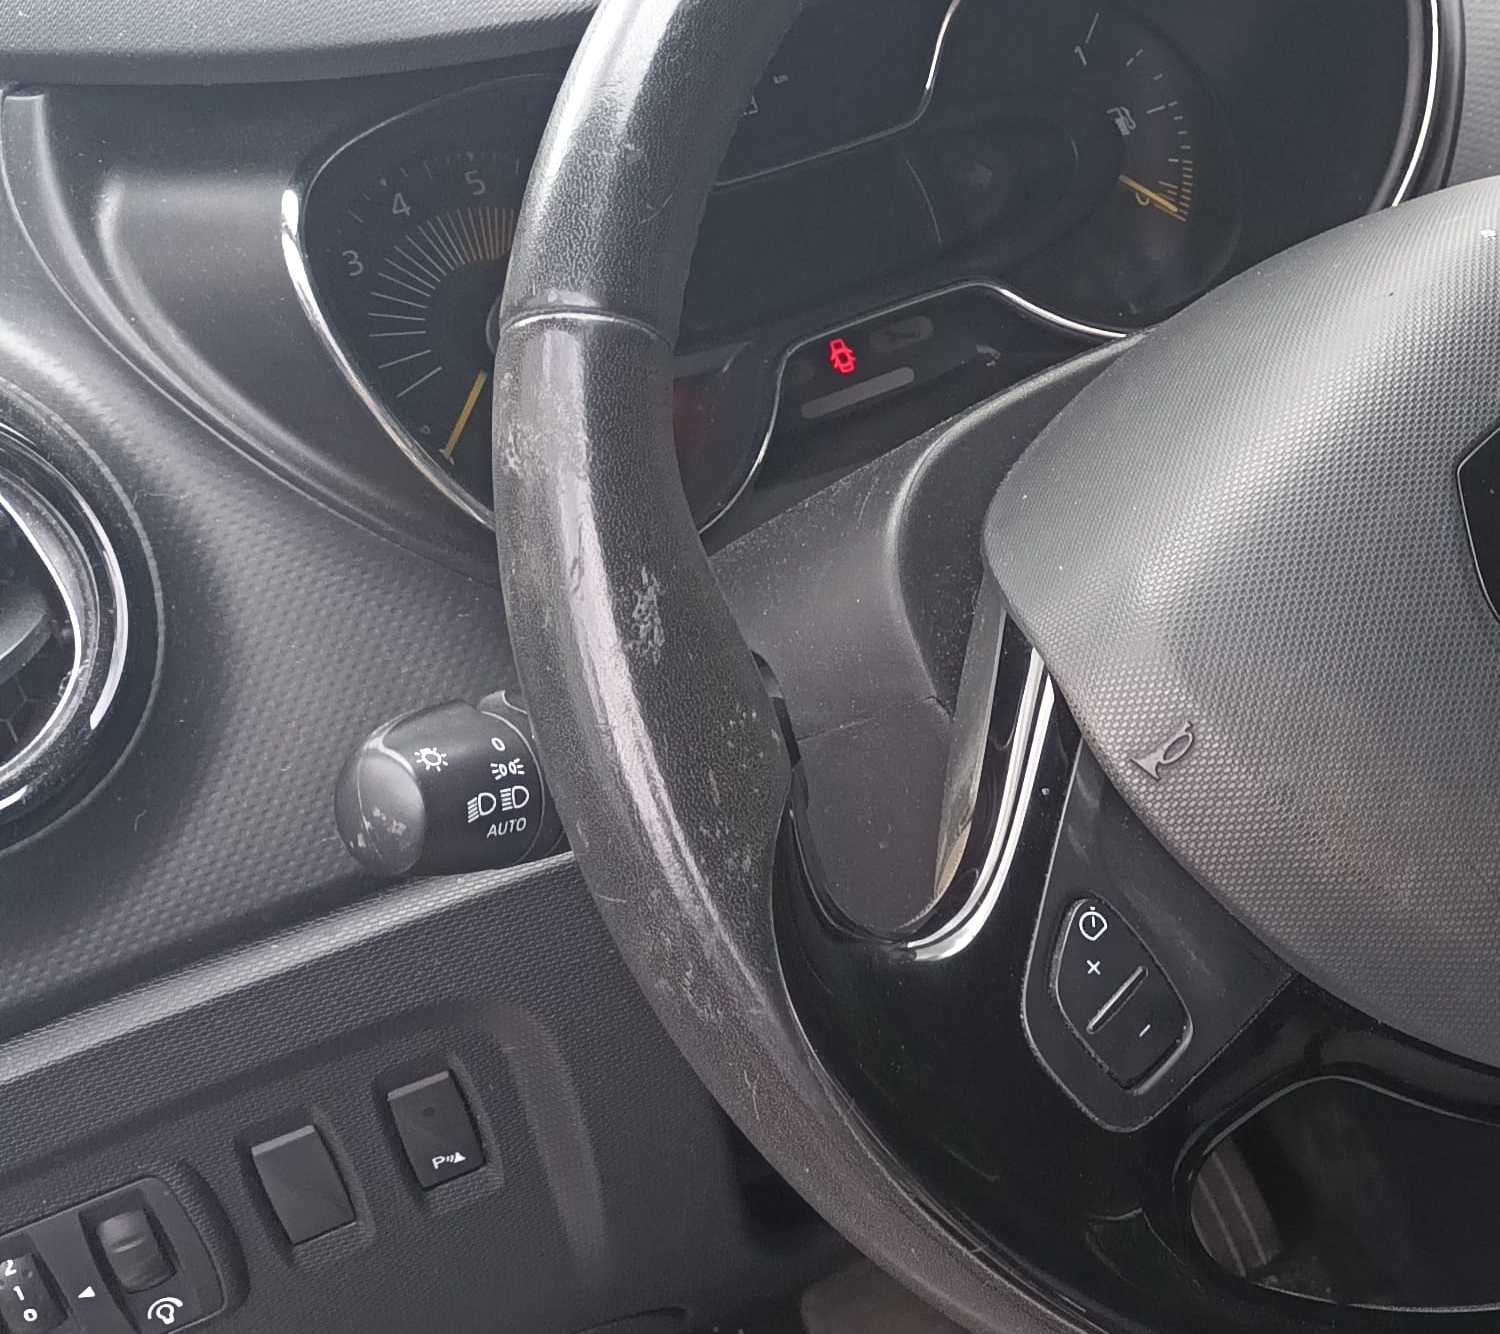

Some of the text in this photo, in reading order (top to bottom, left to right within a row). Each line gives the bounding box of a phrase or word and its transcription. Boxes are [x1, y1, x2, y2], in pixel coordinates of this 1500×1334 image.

[464, 170, 486, 195] 5
[391, 193, 412, 216] 4
[341, 250, 364, 276] 3
[486, 817, 527, 838] AUTO
[4, 1259, 17, 1277] 2
[13, 1285, 25, 1301] 1
